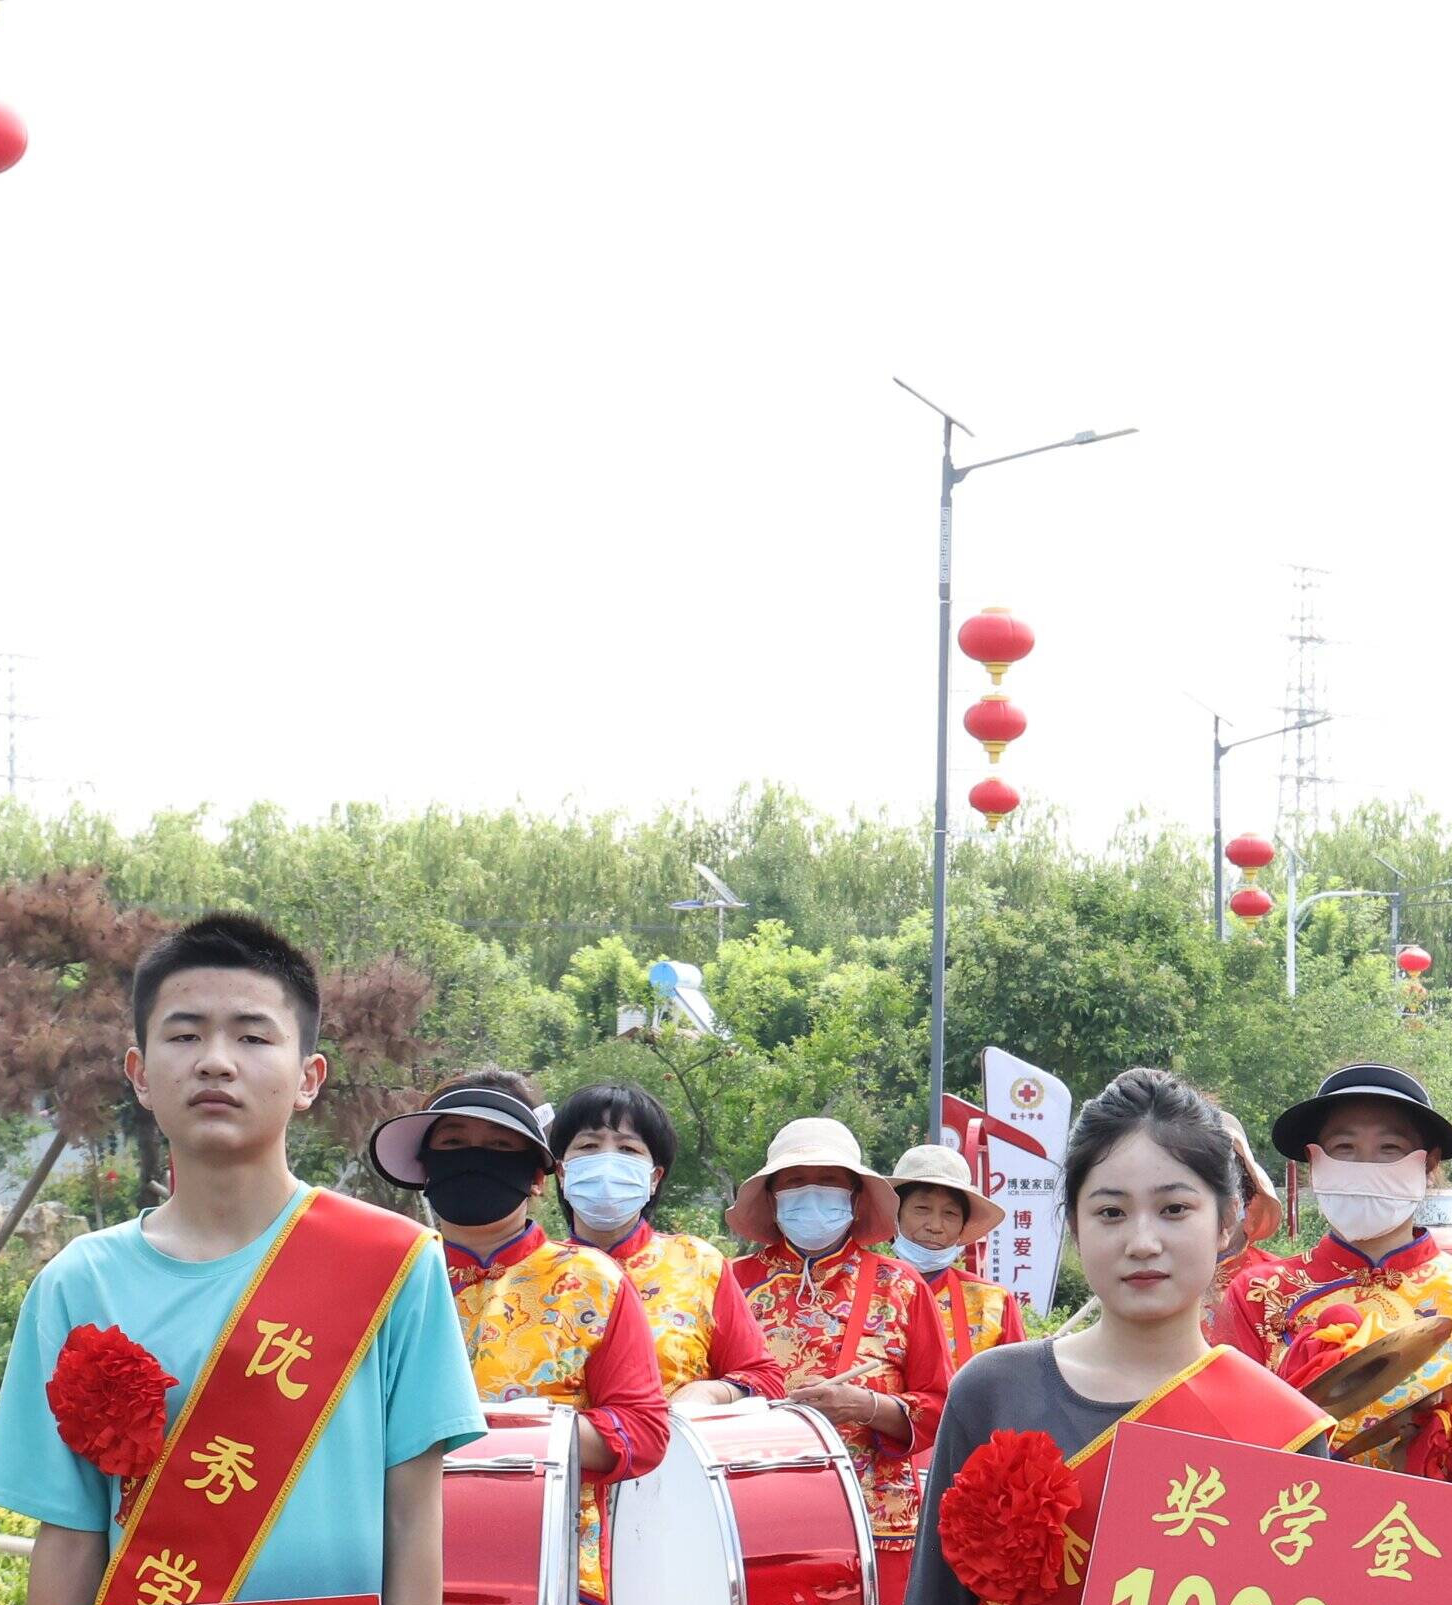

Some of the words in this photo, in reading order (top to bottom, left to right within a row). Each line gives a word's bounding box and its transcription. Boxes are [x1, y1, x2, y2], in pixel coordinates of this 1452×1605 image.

[1007, 1178, 1054, 1190] 博爱家园
[1151, 1462, 1443, 1581] 奖学金
